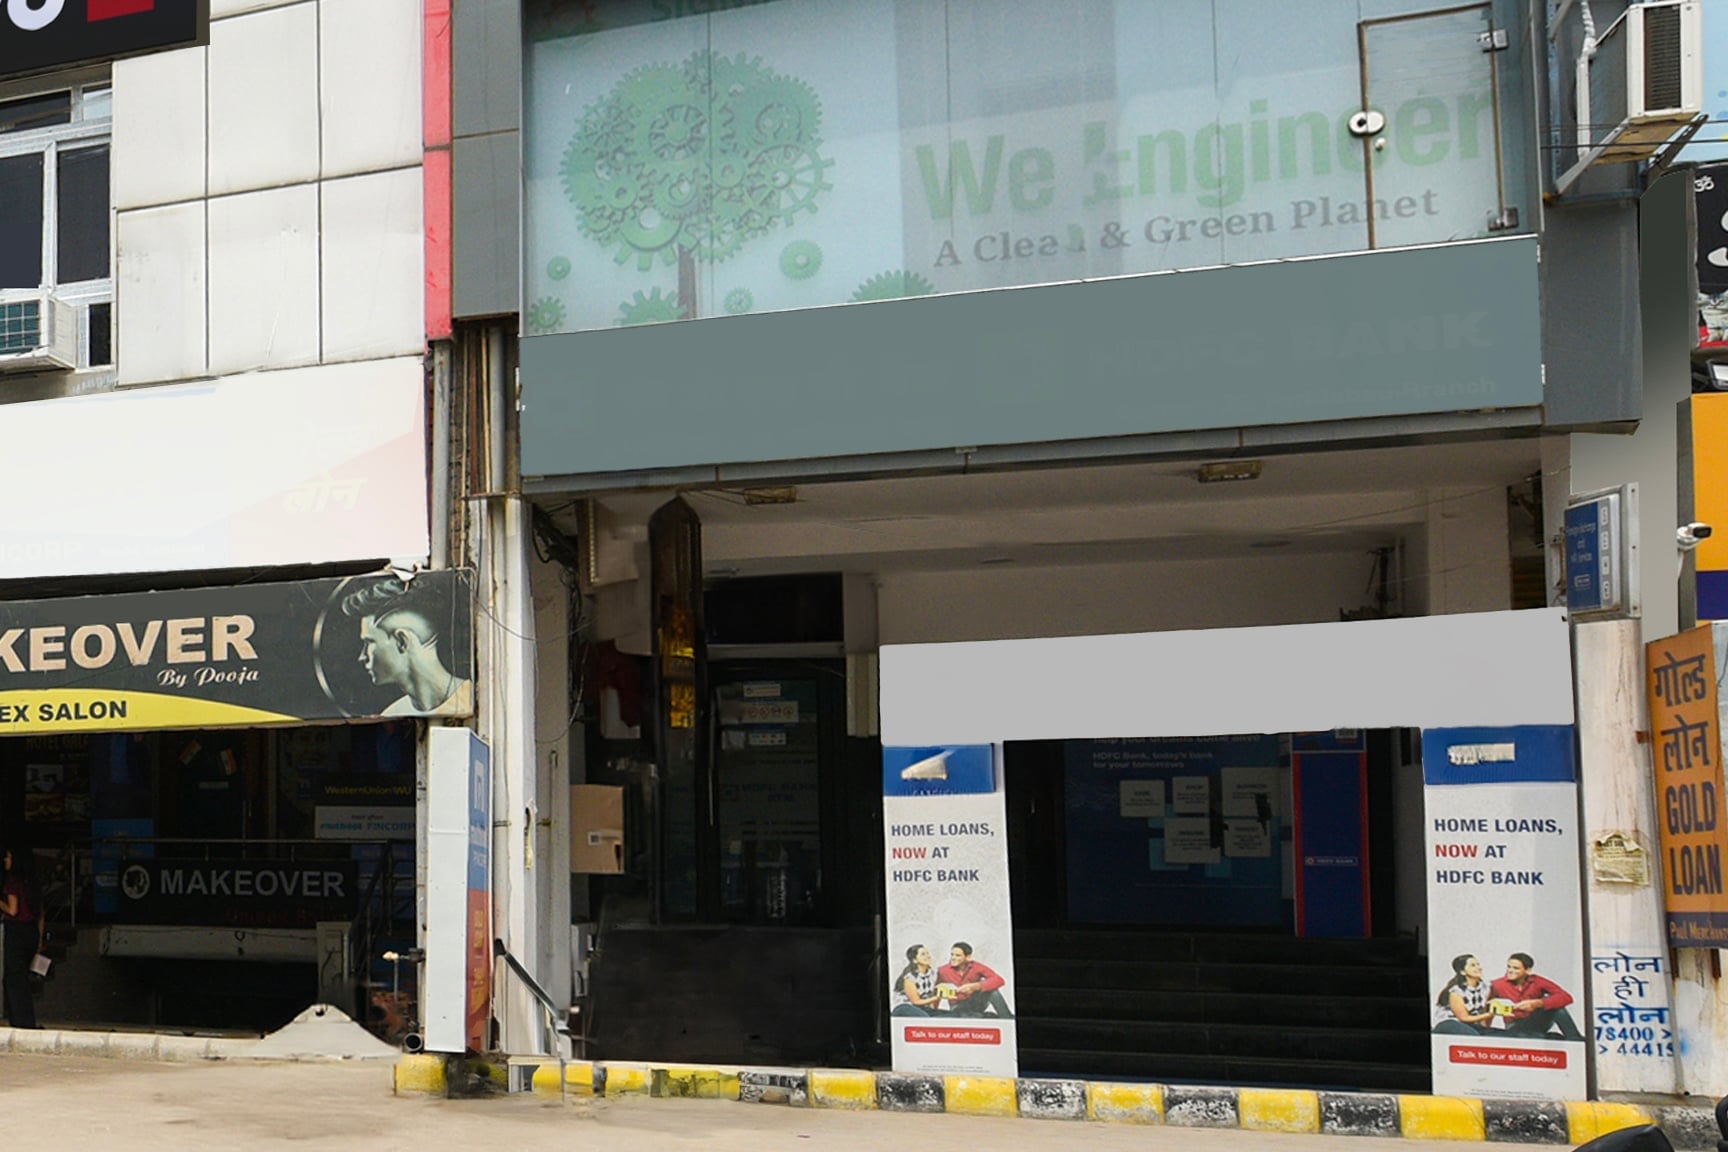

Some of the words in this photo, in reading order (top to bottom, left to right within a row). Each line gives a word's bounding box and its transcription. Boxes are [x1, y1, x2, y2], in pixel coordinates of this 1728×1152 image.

[914, 130, 1056, 221] We
[933, 237, 962, 267] A
[1099, 219, 1131, 250] &
[1144, 201, 1274, 245] Green
[1289, 185, 1440, 231] Planet
[158, 669, 187, 689] By
[193, 667, 260, 689] Pooja
[38, 699, 128, 722] SALON
[1660, 713, 1709, 772] लोन
[1665, 780, 1717, 836] GOLD
[891, 824, 935, 837] HOME
[940, 823, 995, 837] LOANS,
[1434, 818, 1489, 833] HOME
[1494, 819, 1564, 836] LOANS,
[892, 848, 927, 860] NOW
[931, 847, 950, 859] AT
[1434, 845, 1478, 858] NOW
[1484, 845, 1507, 858] AT
[893, 870, 932, 882] HDFC
[937, 869, 980, 882] BANK
[1436, 871, 1486, 884] HDFC
[1491, 871, 1545, 886] BANK
[1672, 844, 1723, 896] LOAN
[159, 868, 346, 897] MAKEOVER
[1591, 951, 1665, 973] लोन
[1613, 975, 1650, 1001] ही
[1595, 1002, 1670, 1024] लोन
[911, 1029, 925, 1039] Talk
[926, 1030, 936, 1039] to
[937, 1032, 951, 1040] our
[953, 1030, 971, 1040] staff
[972, 1031, 994, 1042] today
[1457, 1049, 1477, 1060] Talk
[1478, 1051, 1489, 1060] to
[1490, 1053, 1506, 1061] our
[1508, 1052, 1529, 1063] staff
[1531, 1054, 1558, 1067] today
